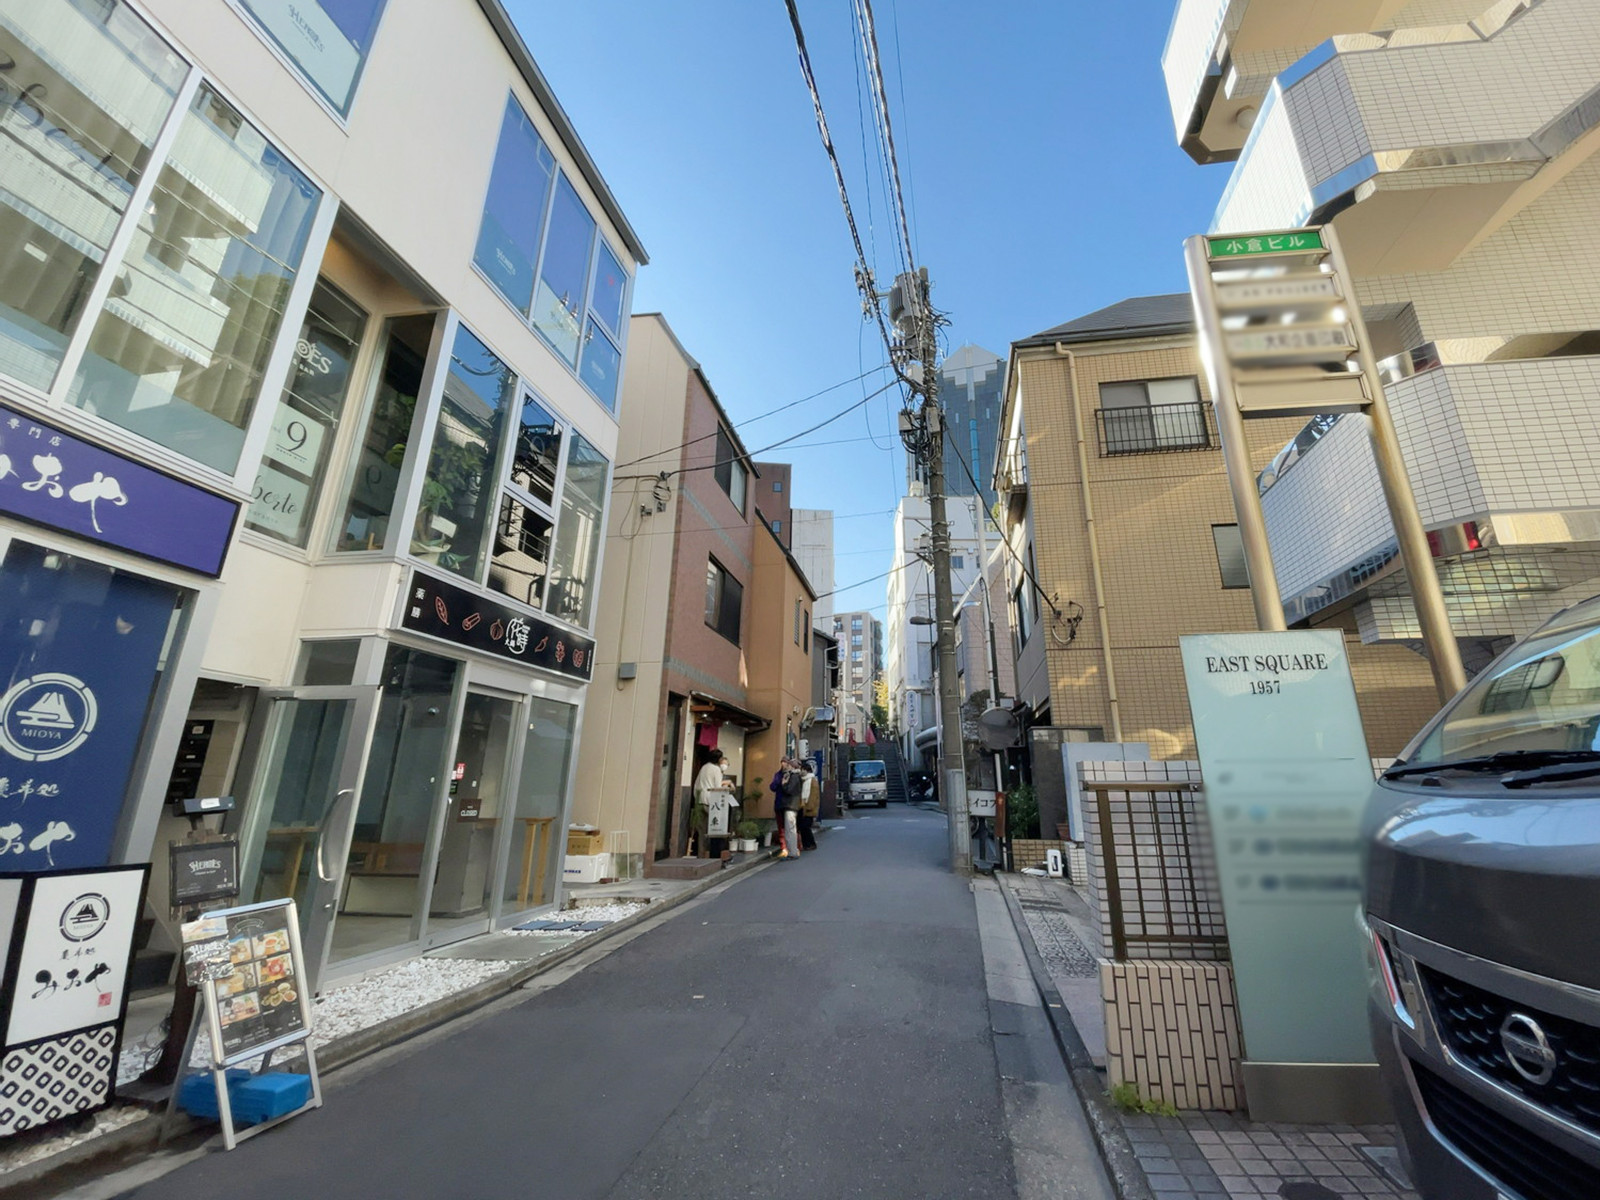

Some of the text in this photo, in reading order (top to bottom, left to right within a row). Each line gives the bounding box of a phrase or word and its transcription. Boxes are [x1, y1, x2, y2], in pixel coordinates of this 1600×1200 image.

[1226, 235, 1305, 254] 小倉ビル
[286, 421, 307, 452] 9
[1206, 653, 1329, 674] EAST SQUARE
[1250, 680, 1282, 696] 1957
[21, 727, 62, 740] MIOYA
[31, 962, 111, 1000] みおや
